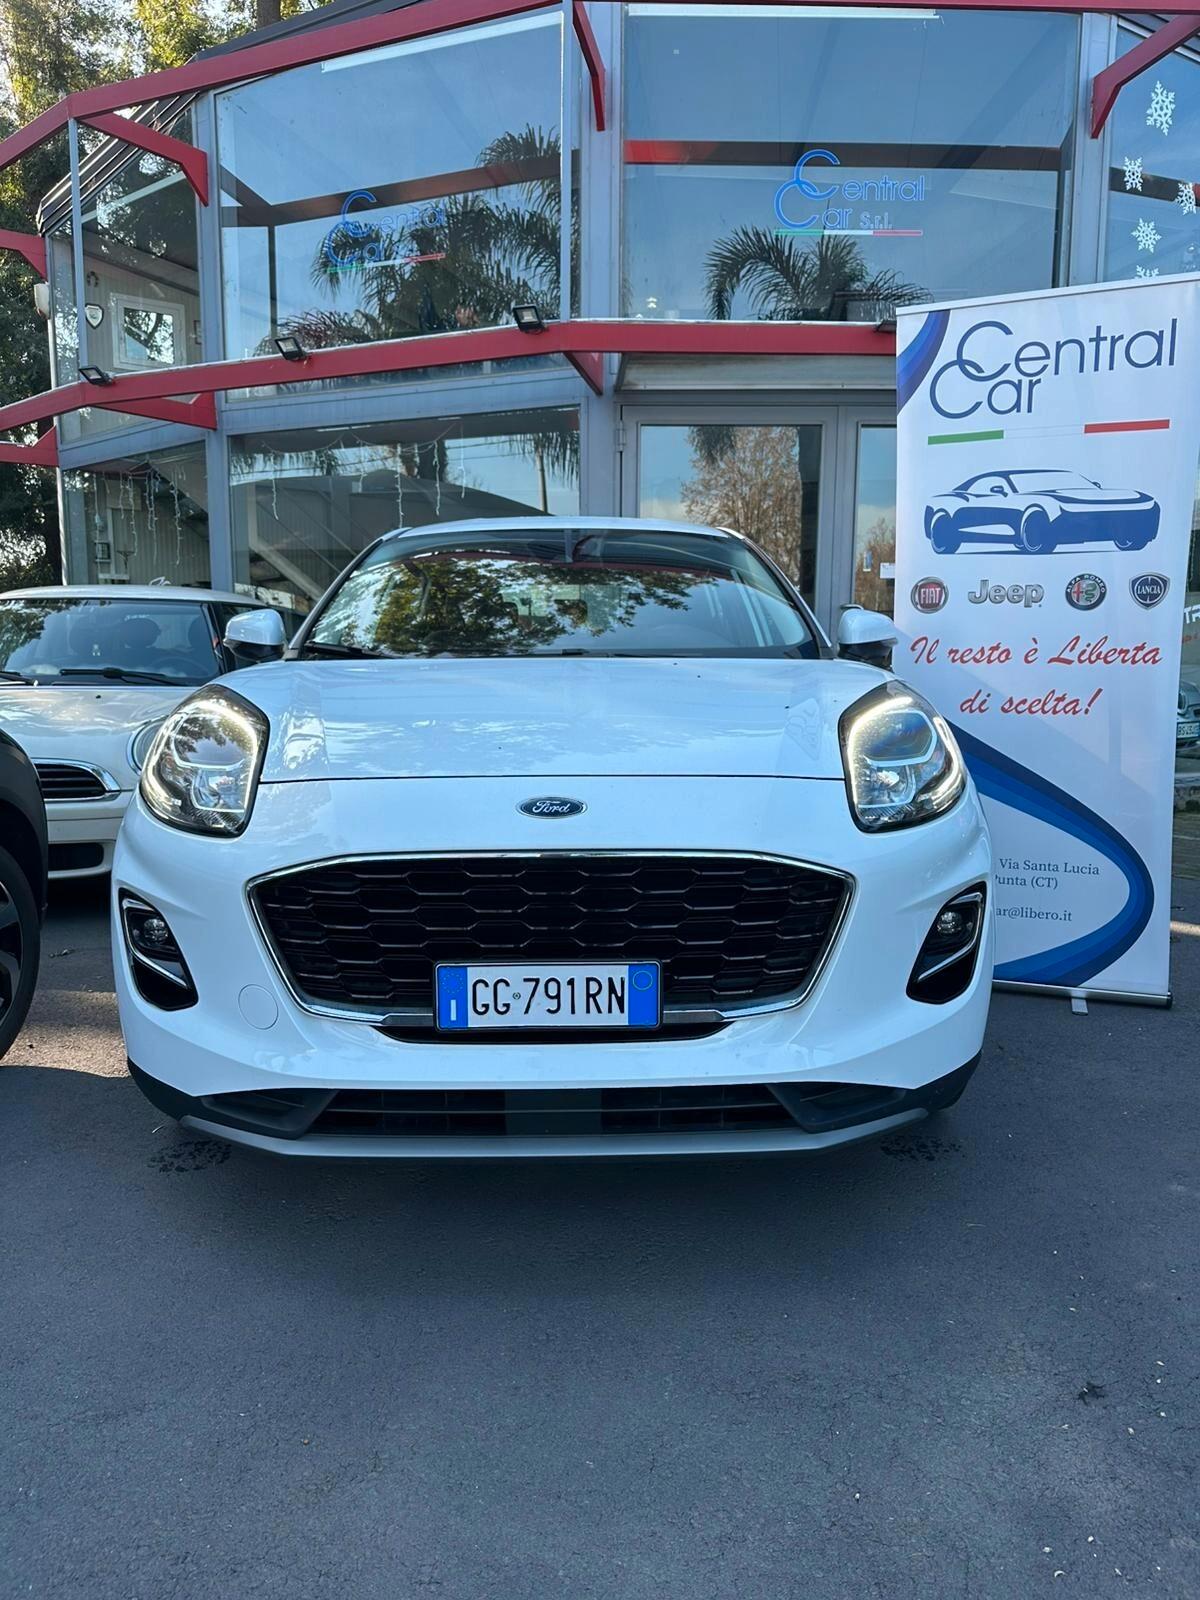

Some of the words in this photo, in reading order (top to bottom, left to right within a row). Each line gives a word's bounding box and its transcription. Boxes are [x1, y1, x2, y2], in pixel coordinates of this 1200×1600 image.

[793, 149, 925, 201] Central
[774, 178, 853, 229] Car
[325, 221, 389, 266] Ca
[956, 318, 1178, 382] Central
[929, 359, 1041, 419] Car
[920, 588, 941, 604] FIAT
[968, 579, 1043, 608] Jeep
[1137, 585, 1161, 595] LANCIA
[910, 636, 940, 664] Il
[947, 641, 1012, 664] resto
[1023, 637, 1039, 664] è
[1048, 635, 1162, 665] Liberta
[960, 689, 991, 714] di
[1000, 687, 1103, 715] scelta!
[532, 800, 571, 813] Ford
[999, 858, 1019, 870] Via
[1023, 860, 1059, 872] Santa
[1064, 862, 1099, 875] Lucia
[1031, 876, 1058, 889] (CT)
